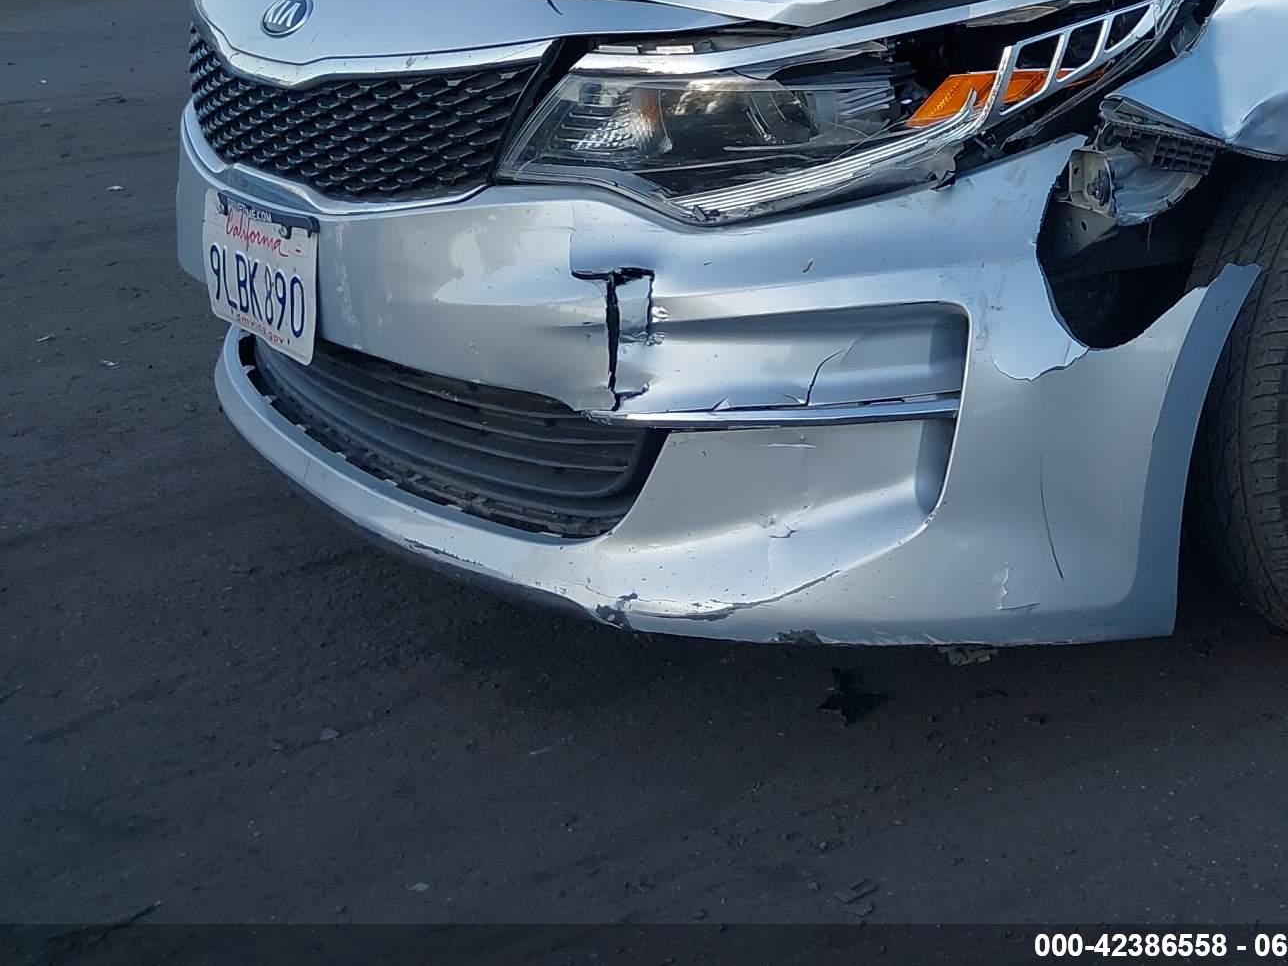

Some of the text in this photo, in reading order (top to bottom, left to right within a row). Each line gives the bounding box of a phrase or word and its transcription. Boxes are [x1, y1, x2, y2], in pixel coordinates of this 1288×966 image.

[263, 0, 301, 27] KIA
[225, 209, 289, 257] California
[209, 243, 306, 339] 9LBK890
[235, 313, 284, 346] dmv.ca.gov
